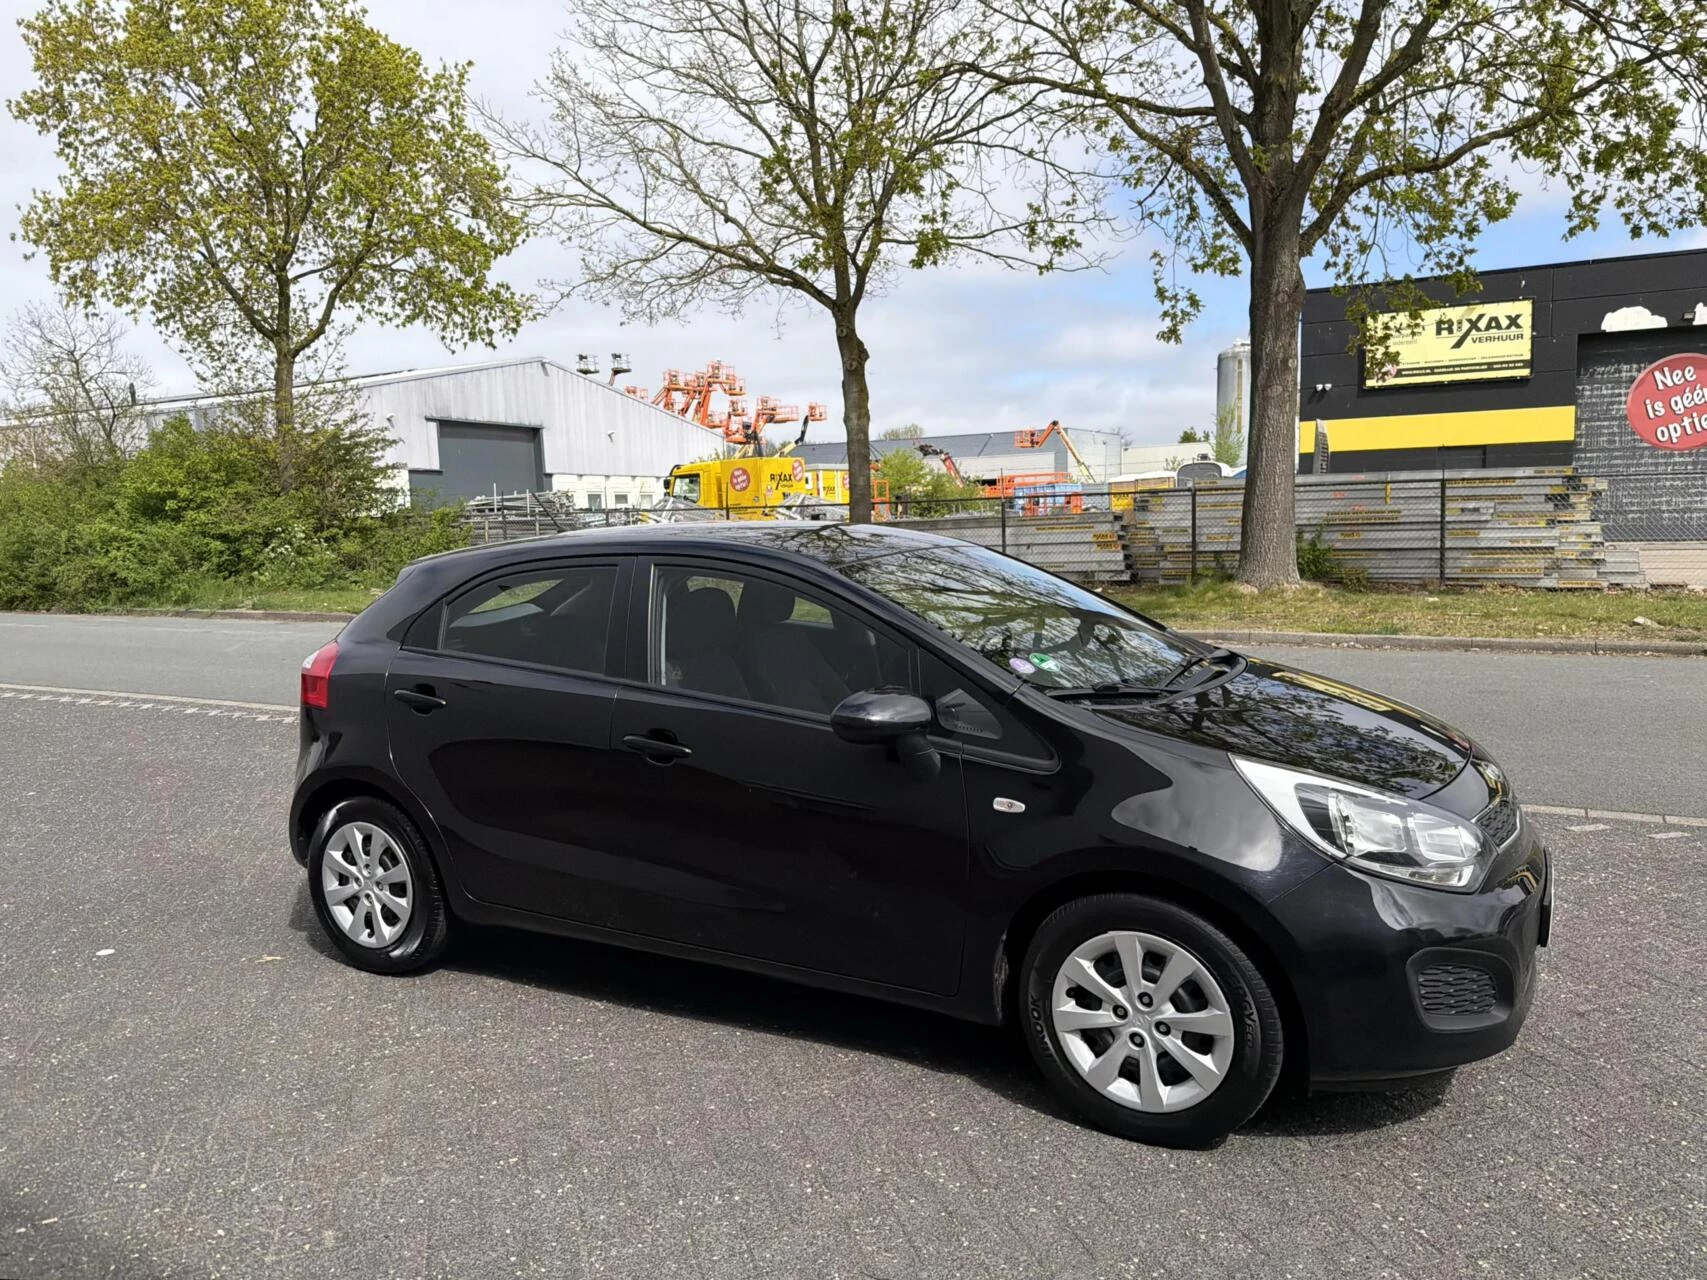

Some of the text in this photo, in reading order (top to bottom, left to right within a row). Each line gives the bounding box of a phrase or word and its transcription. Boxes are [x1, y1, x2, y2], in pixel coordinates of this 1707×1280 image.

[1471, 332, 1525, 344] VERHUUR
[1653, 365, 1697, 391] Nee
[1643, 399, 1666, 419] is
